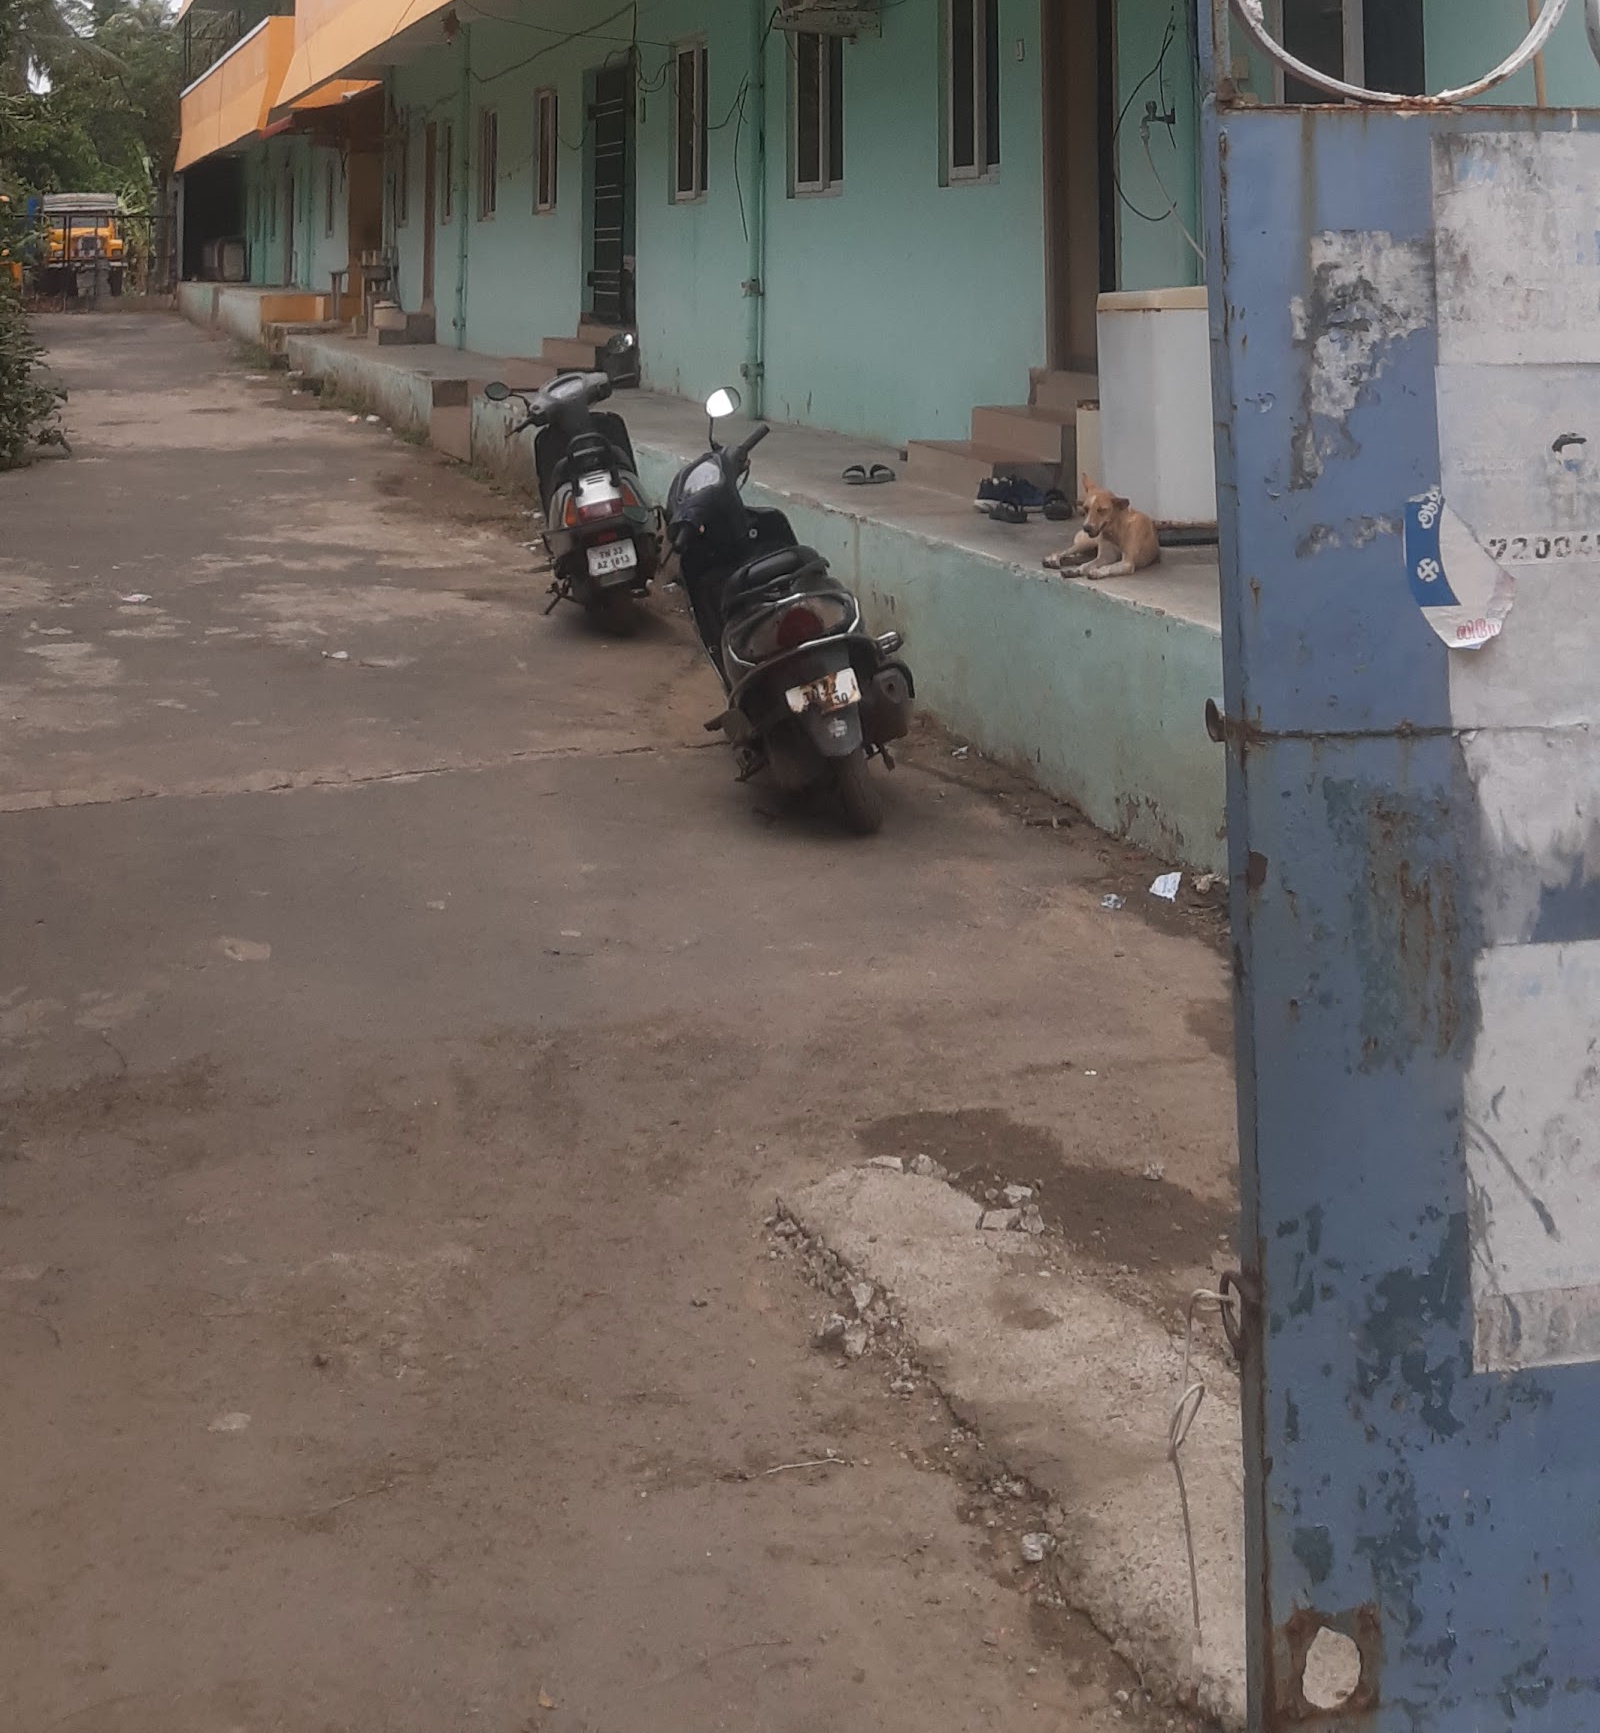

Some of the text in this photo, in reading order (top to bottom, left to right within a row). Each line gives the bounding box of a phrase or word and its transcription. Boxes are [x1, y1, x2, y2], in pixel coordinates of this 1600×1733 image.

[599, 547, 623, 558] TN 33
[597, 560, 608, 569] AZ
